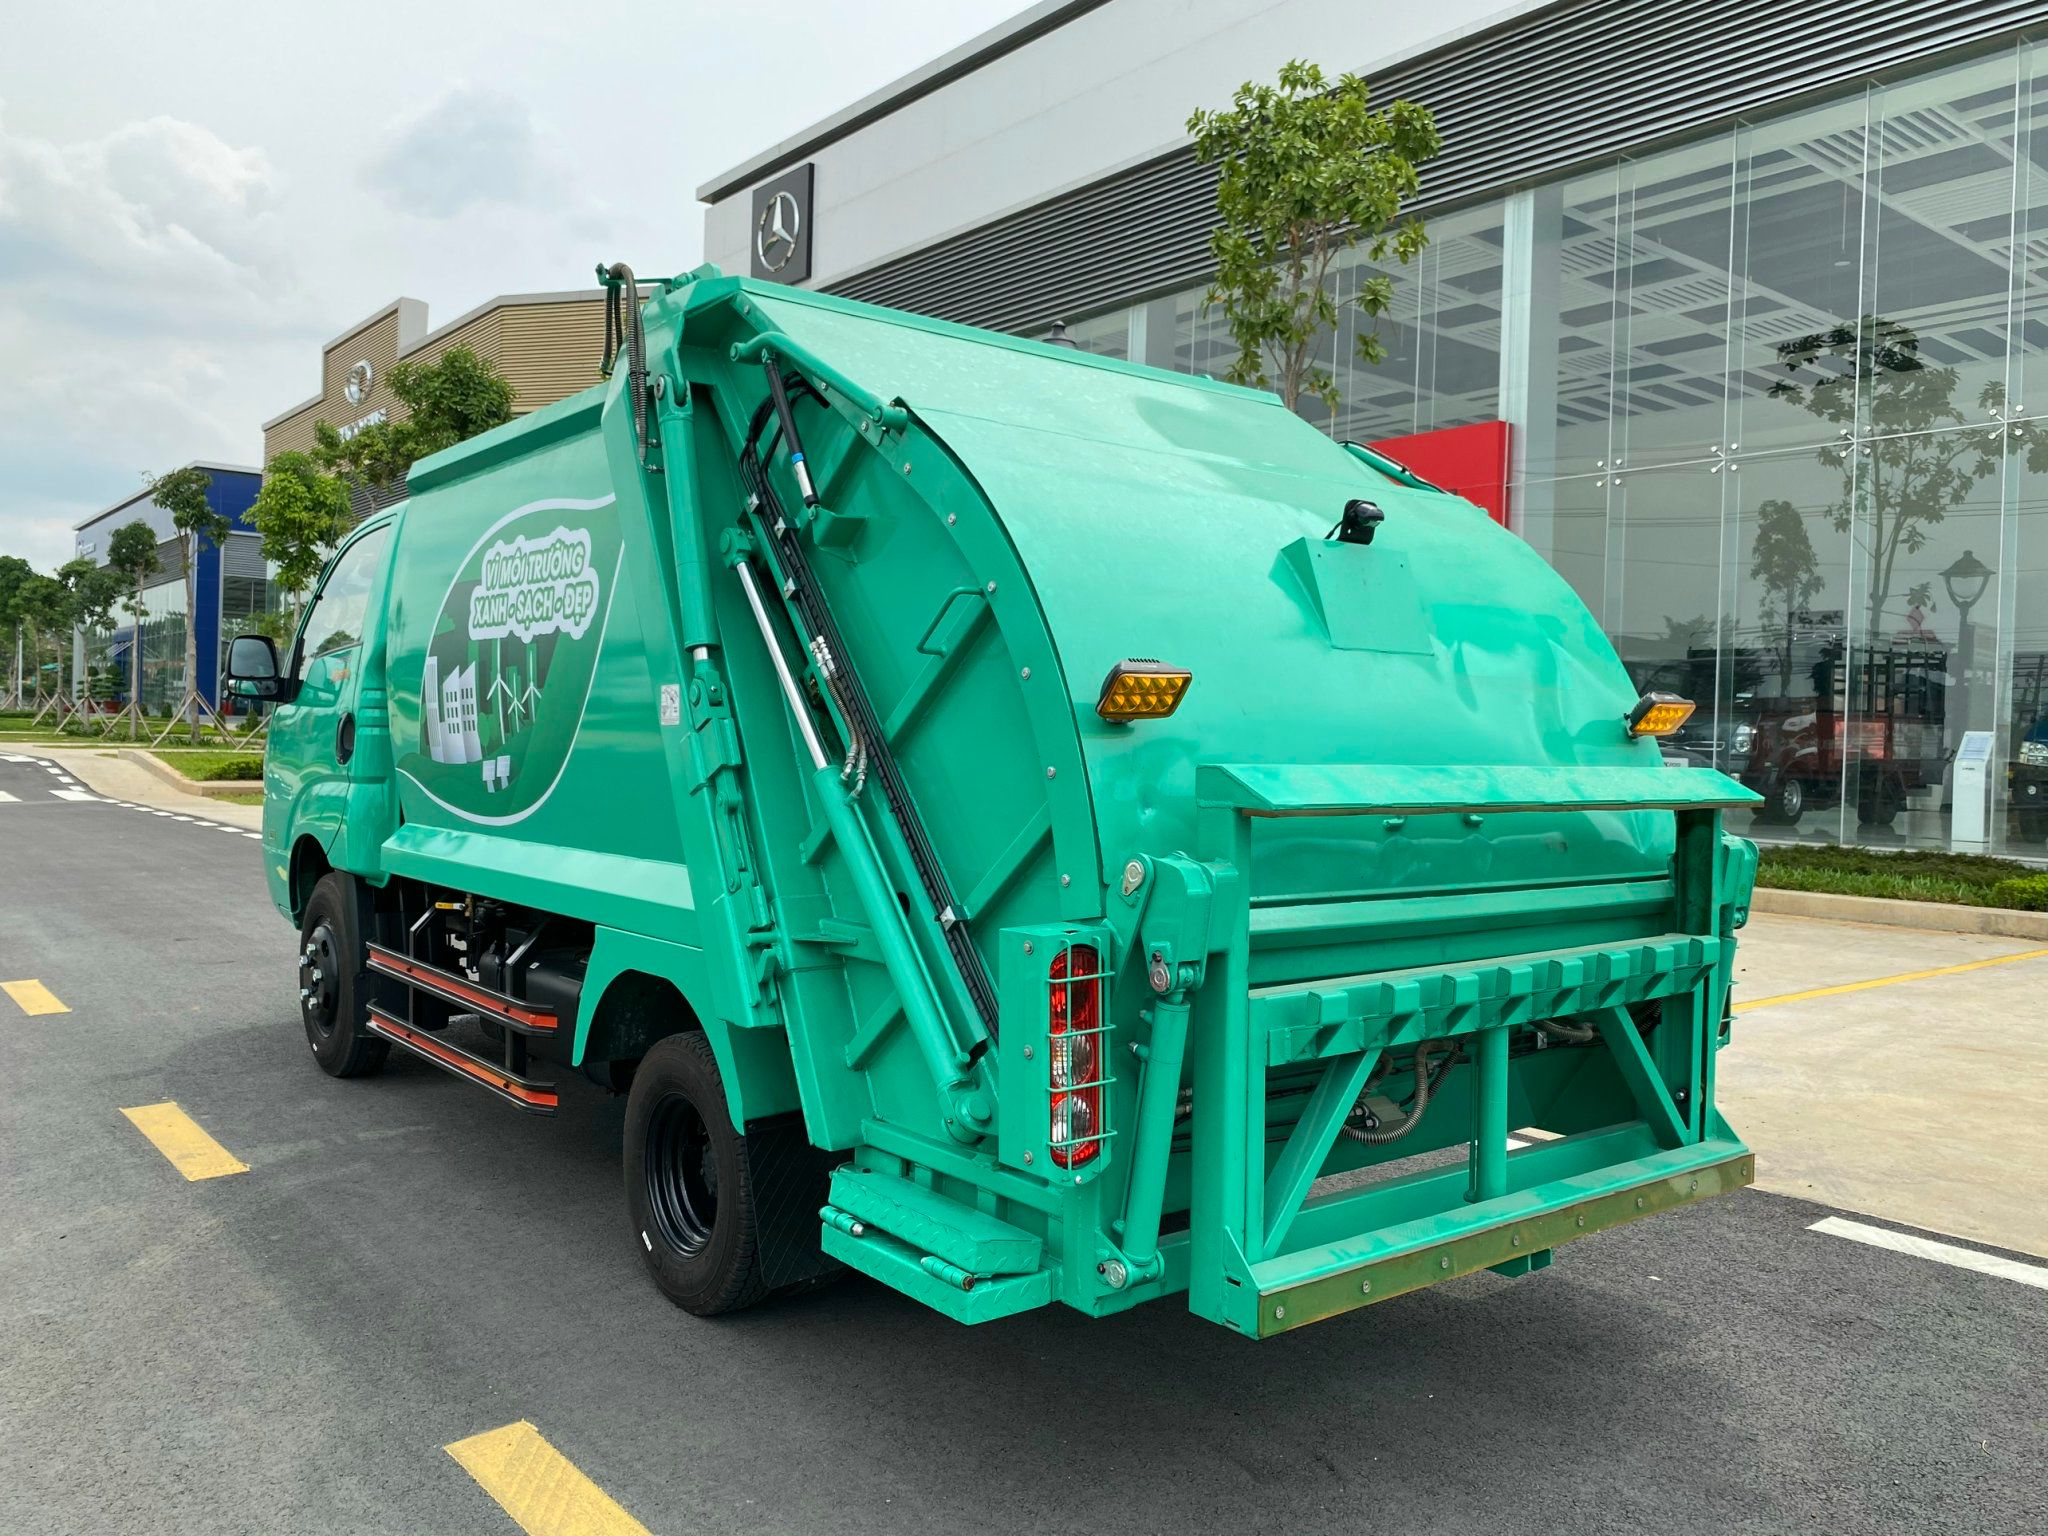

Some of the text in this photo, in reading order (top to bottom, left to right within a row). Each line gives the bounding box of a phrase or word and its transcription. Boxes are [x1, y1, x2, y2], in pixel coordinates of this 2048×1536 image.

[500, 547, 528, 588] MÔI
[527, 539, 586, 583] TRƯỜNG
[473, 593, 508, 628] XANH
[516, 587, 555, 630] SẠCH
[563, 581, 593, 626] ĐẸP
